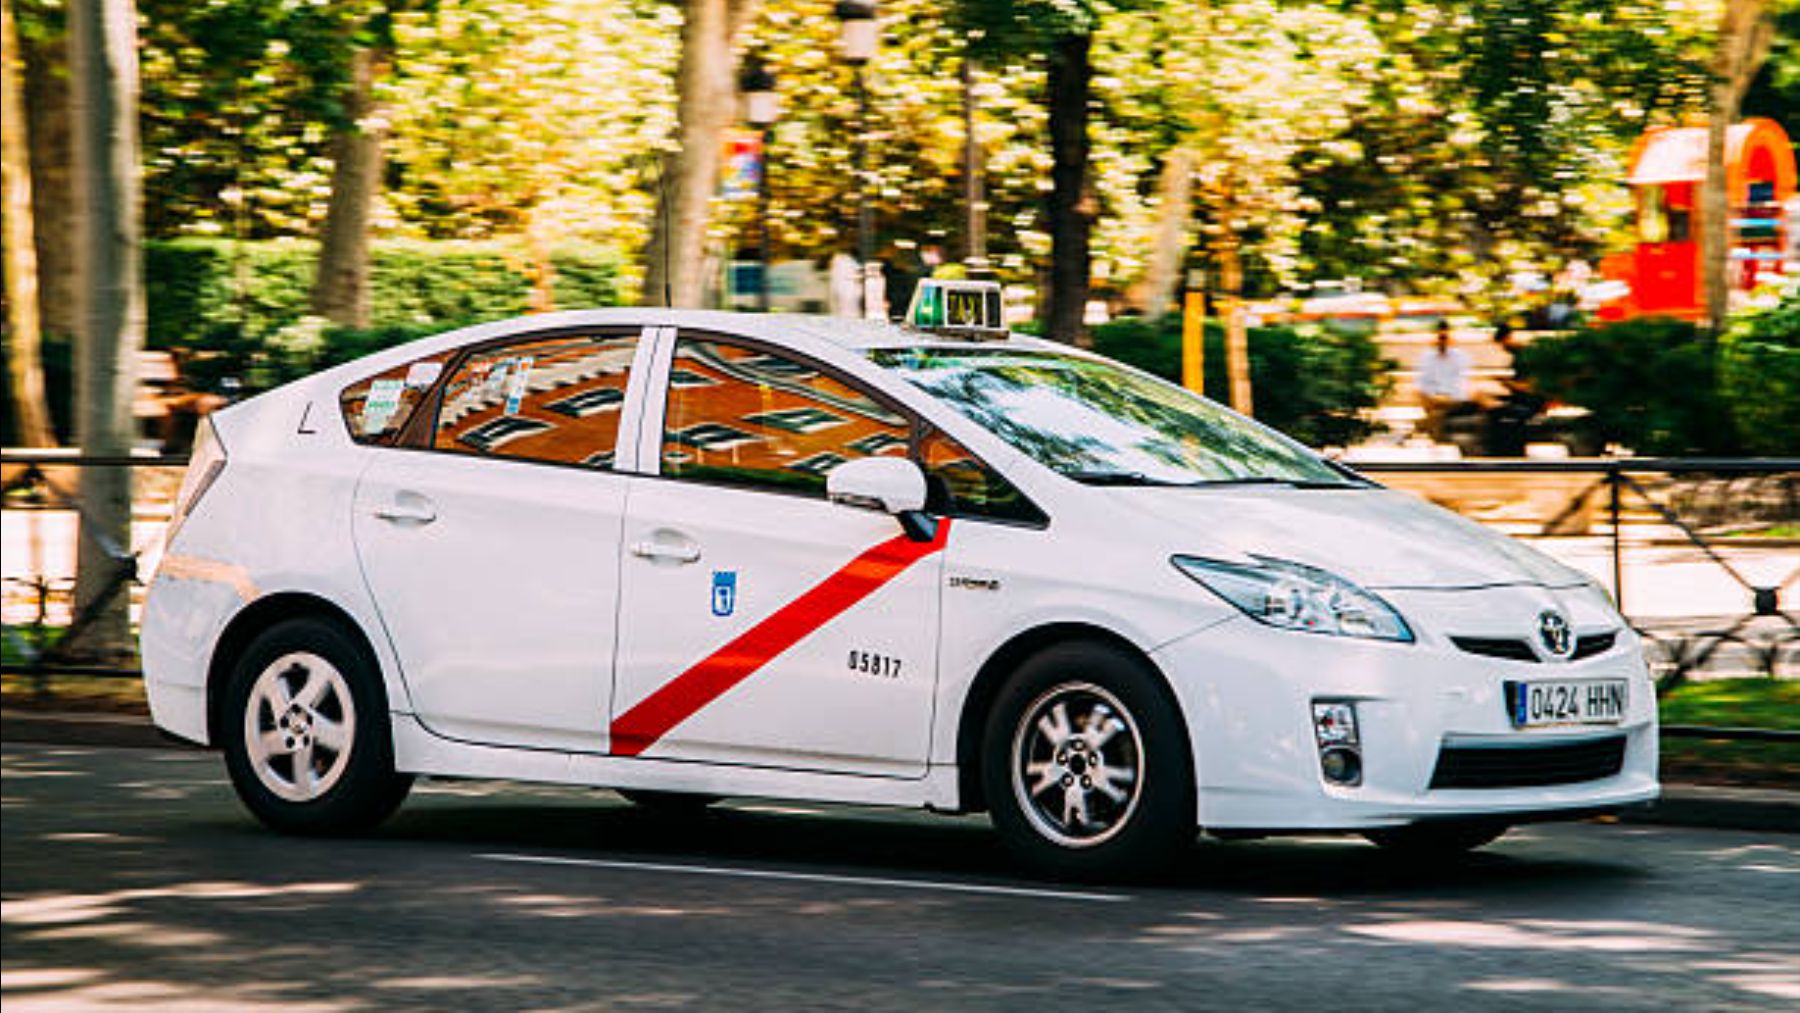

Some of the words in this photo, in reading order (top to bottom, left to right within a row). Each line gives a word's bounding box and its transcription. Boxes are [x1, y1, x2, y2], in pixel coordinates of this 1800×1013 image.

[297, 401, 316, 434] L
[848, 650, 902, 678] 05817
[1531, 685, 1578, 719] 0424
[1587, 684, 1624, 717] HHN
